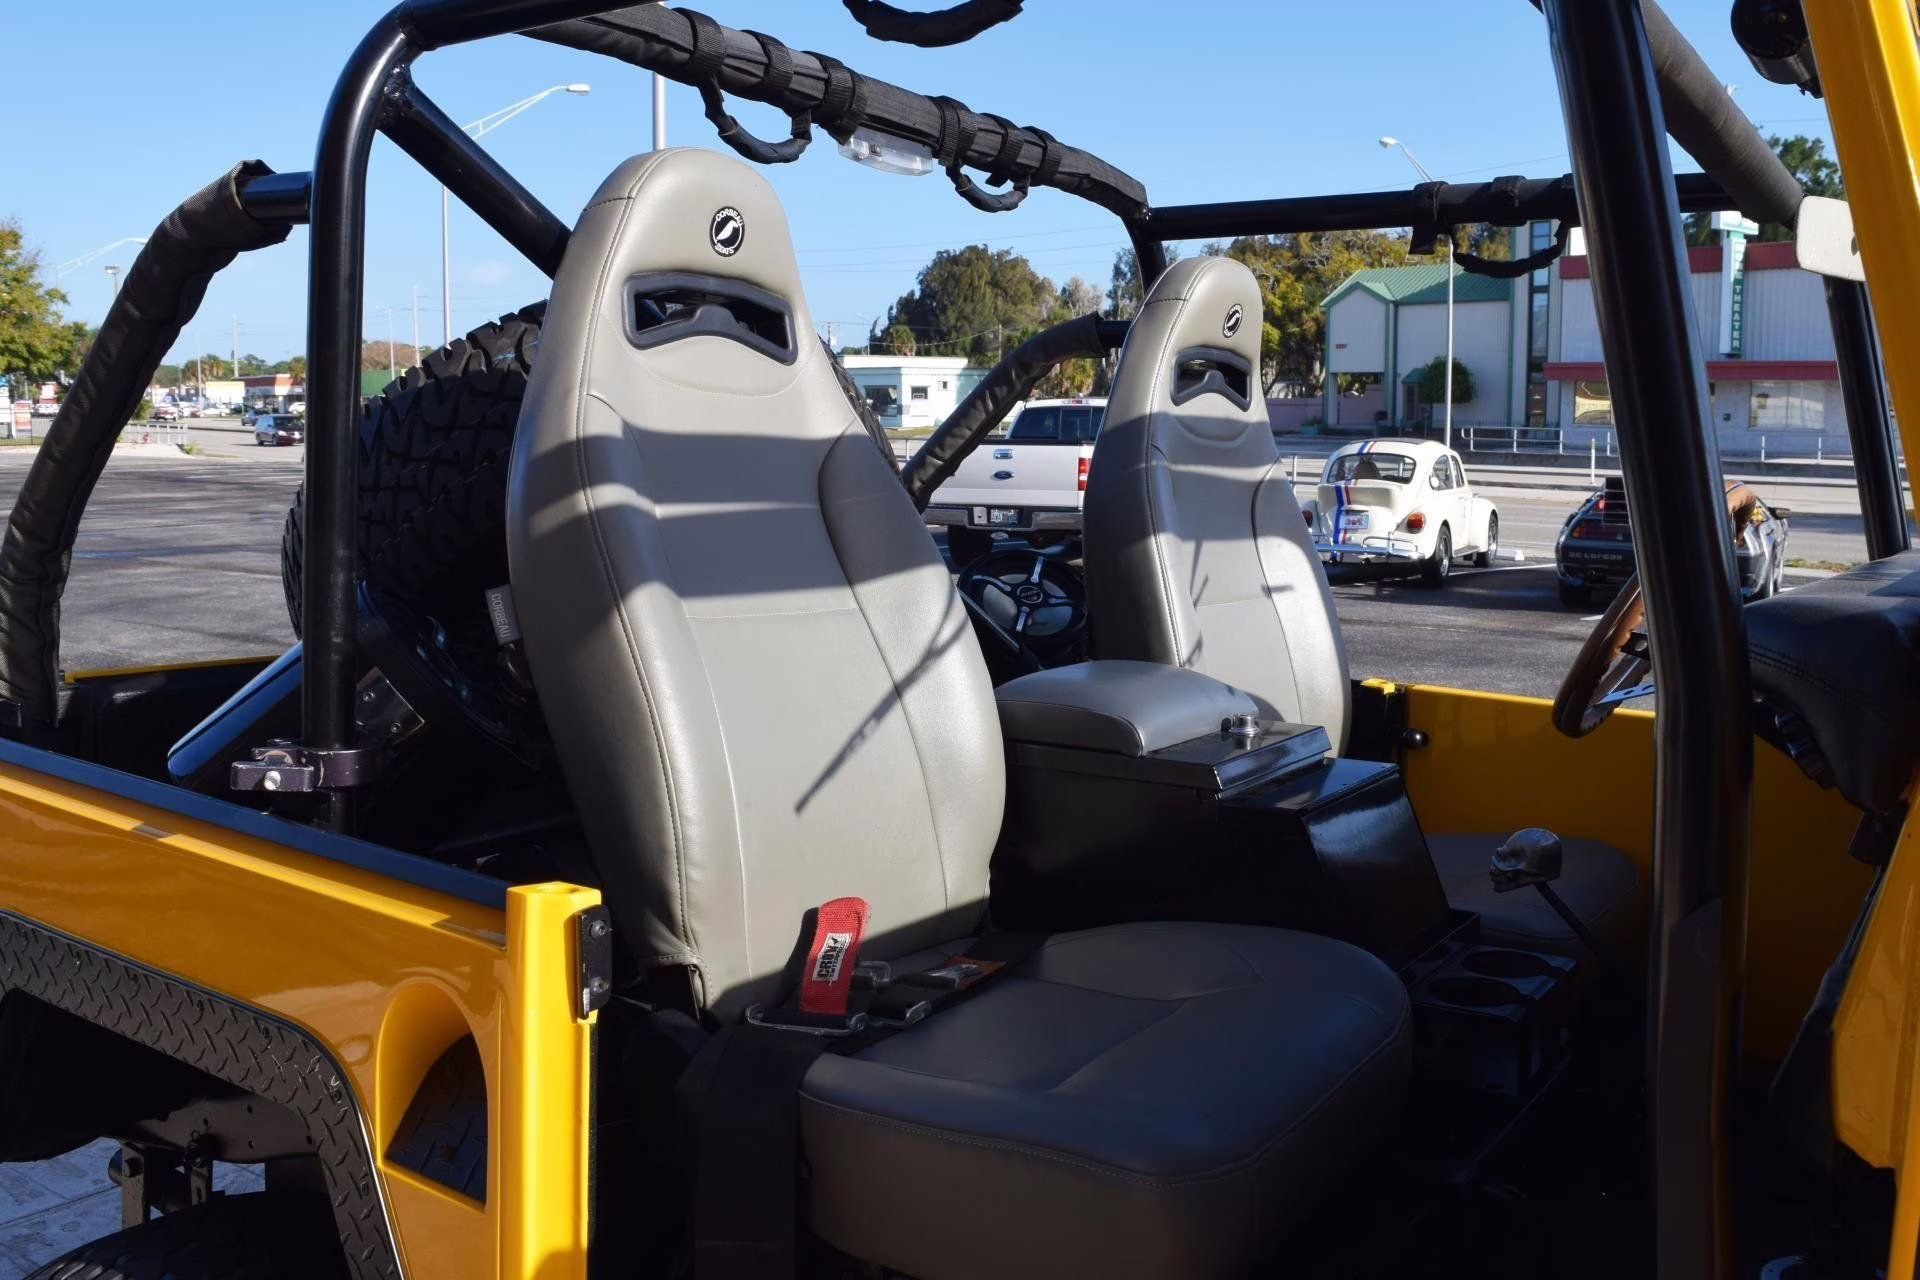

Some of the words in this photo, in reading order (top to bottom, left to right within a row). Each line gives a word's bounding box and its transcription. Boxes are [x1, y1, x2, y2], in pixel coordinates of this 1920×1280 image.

[715, 208, 744, 227] CORBEAU
[1732, 285, 1742, 348] THEATER
[491, 593, 512, 638] CORBEAU
[816, 945, 838, 978] CROW
